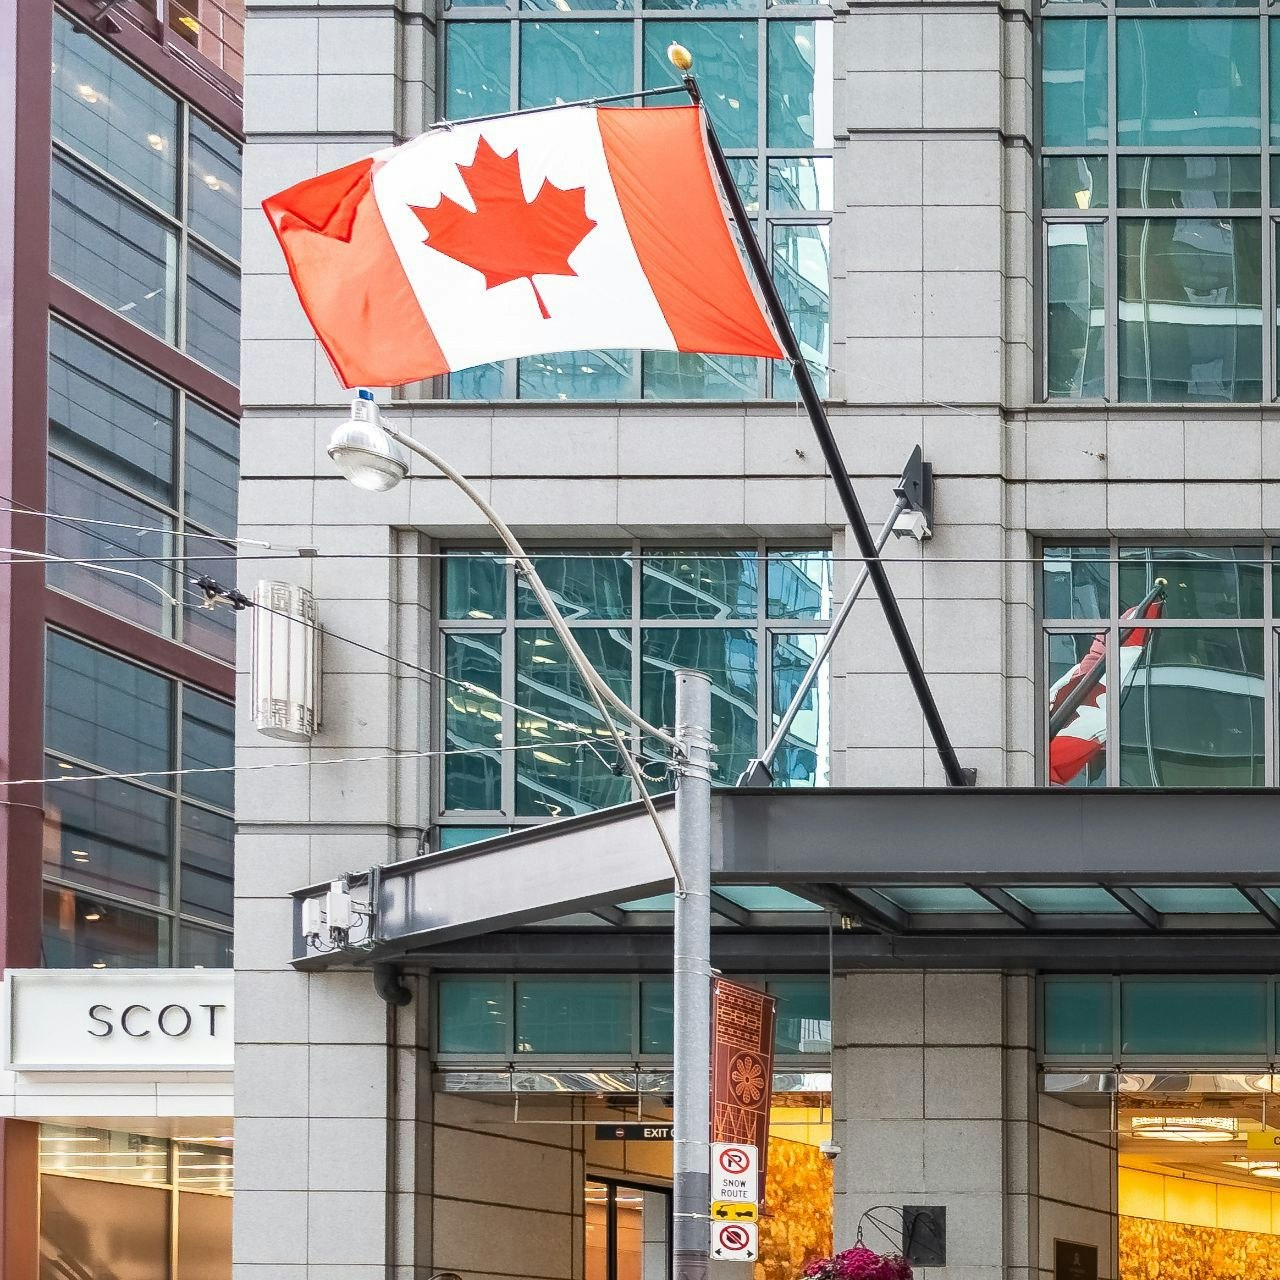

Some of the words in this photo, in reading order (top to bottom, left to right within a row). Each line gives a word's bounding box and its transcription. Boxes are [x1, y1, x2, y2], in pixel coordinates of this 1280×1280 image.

[87, 1004, 226, 1037] SCOT
[644, 1128, 668, 1138] EXIT
[723, 1179, 747, 1188] SNOW
[721, 1188, 748, 1198] ROUTE
